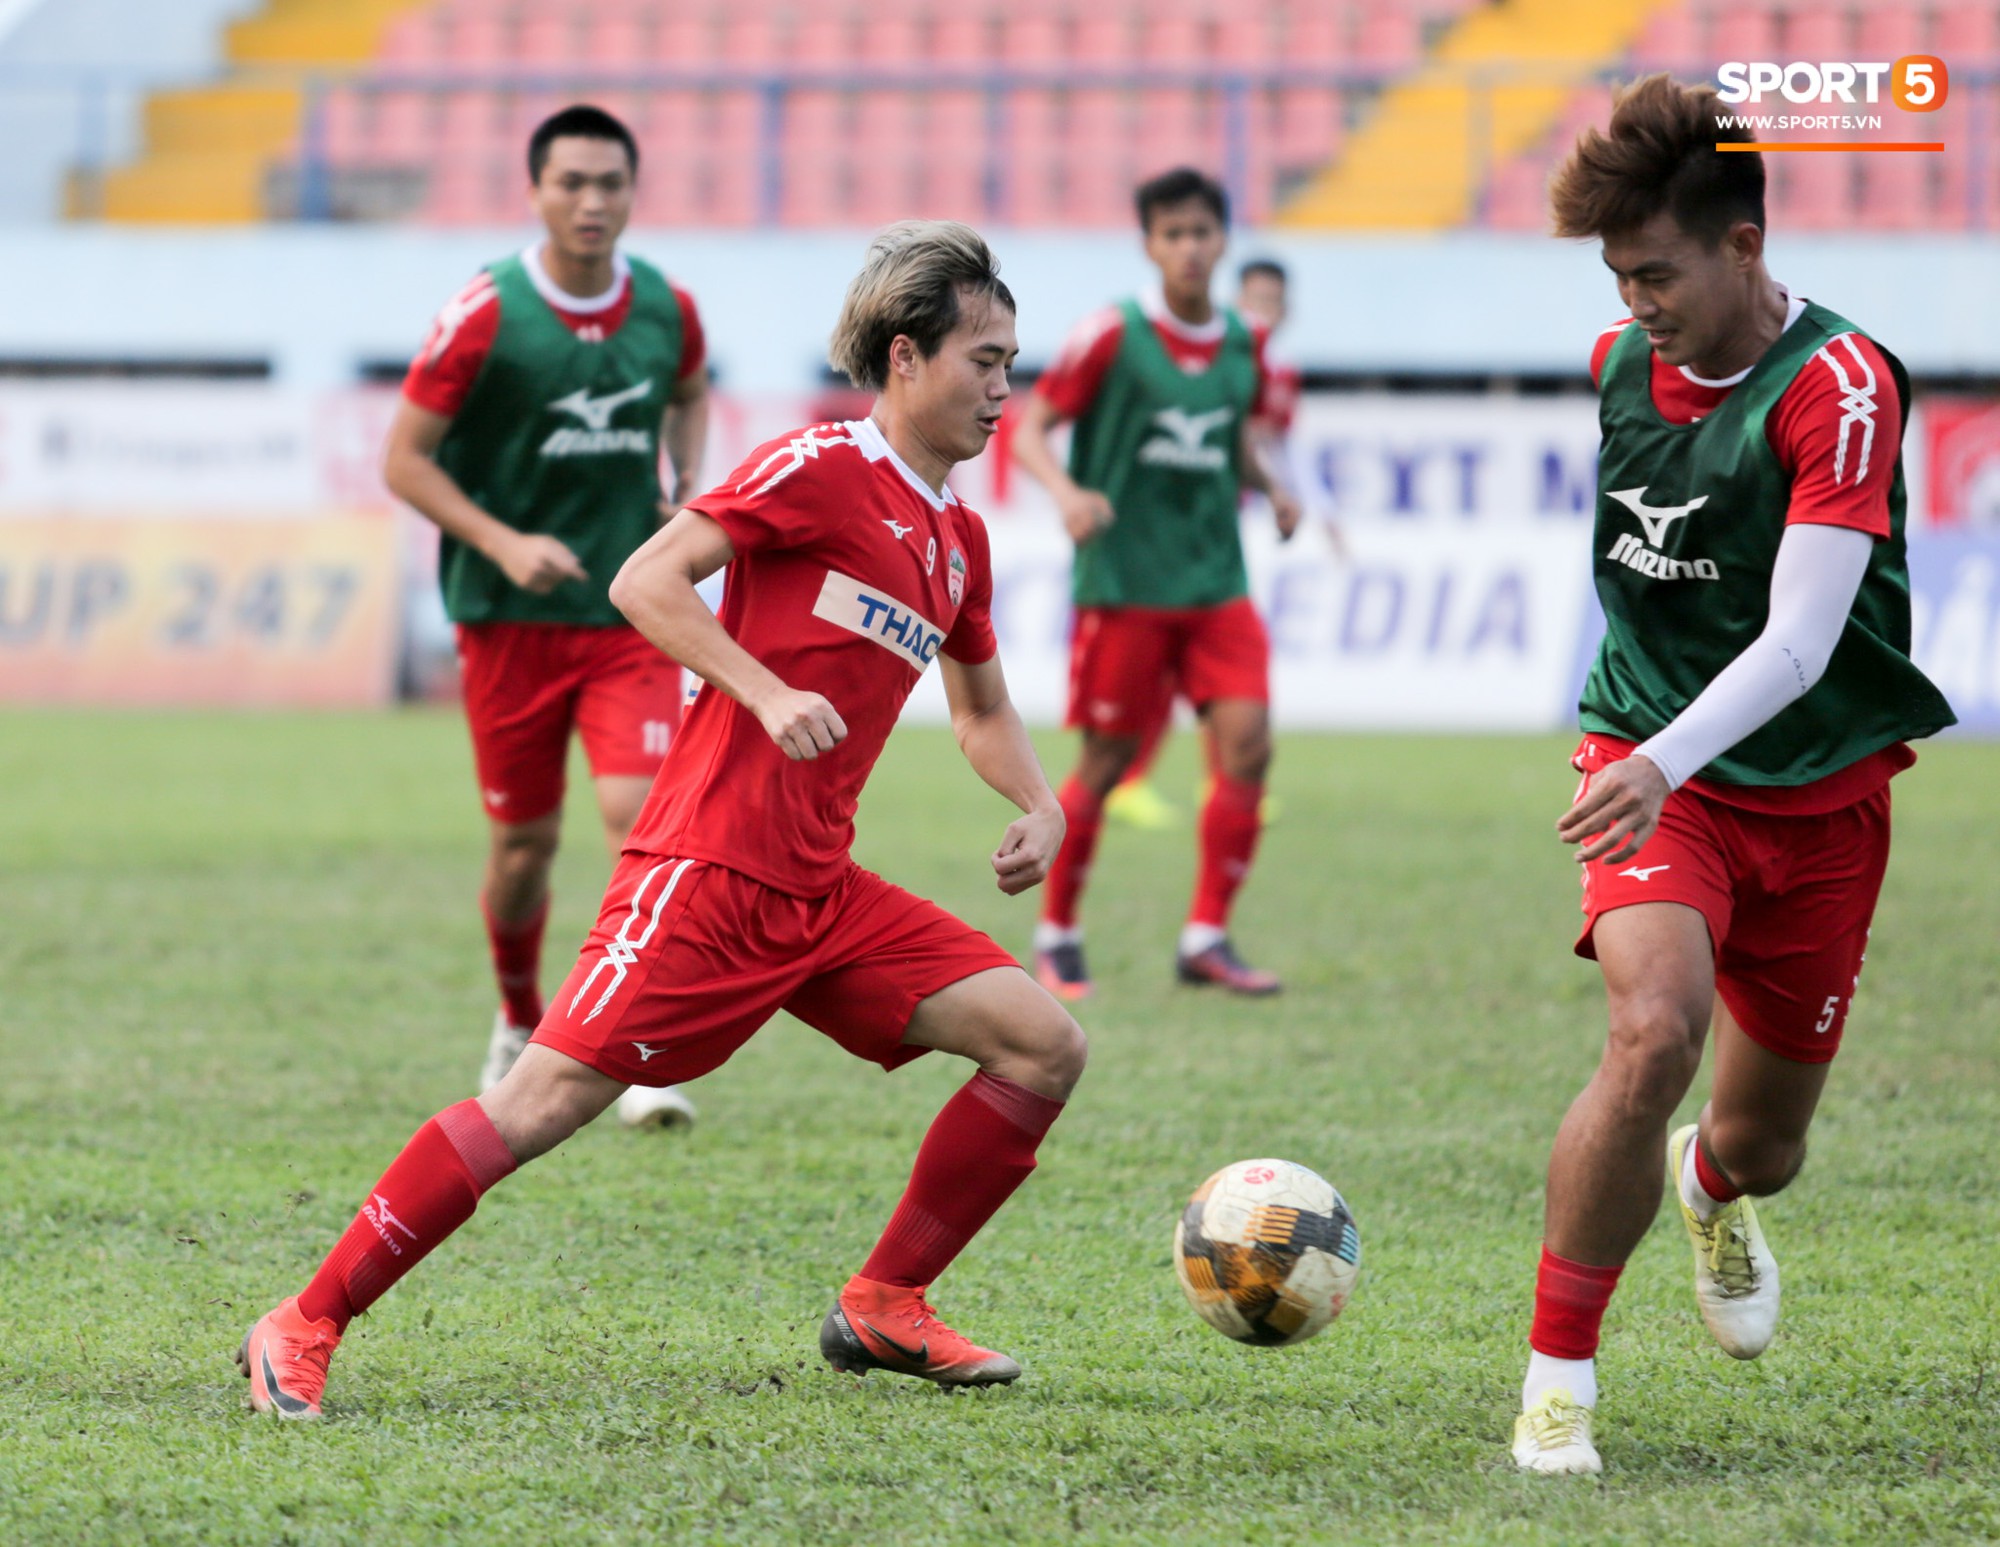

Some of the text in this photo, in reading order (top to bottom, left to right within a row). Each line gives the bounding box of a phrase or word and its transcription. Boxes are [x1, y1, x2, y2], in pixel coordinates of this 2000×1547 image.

[925, 536, 937, 577] 9
[163, 560, 362, 650] 247
[643, 719, 670, 756] 11
[1815, 995, 1840, 1033] 5
